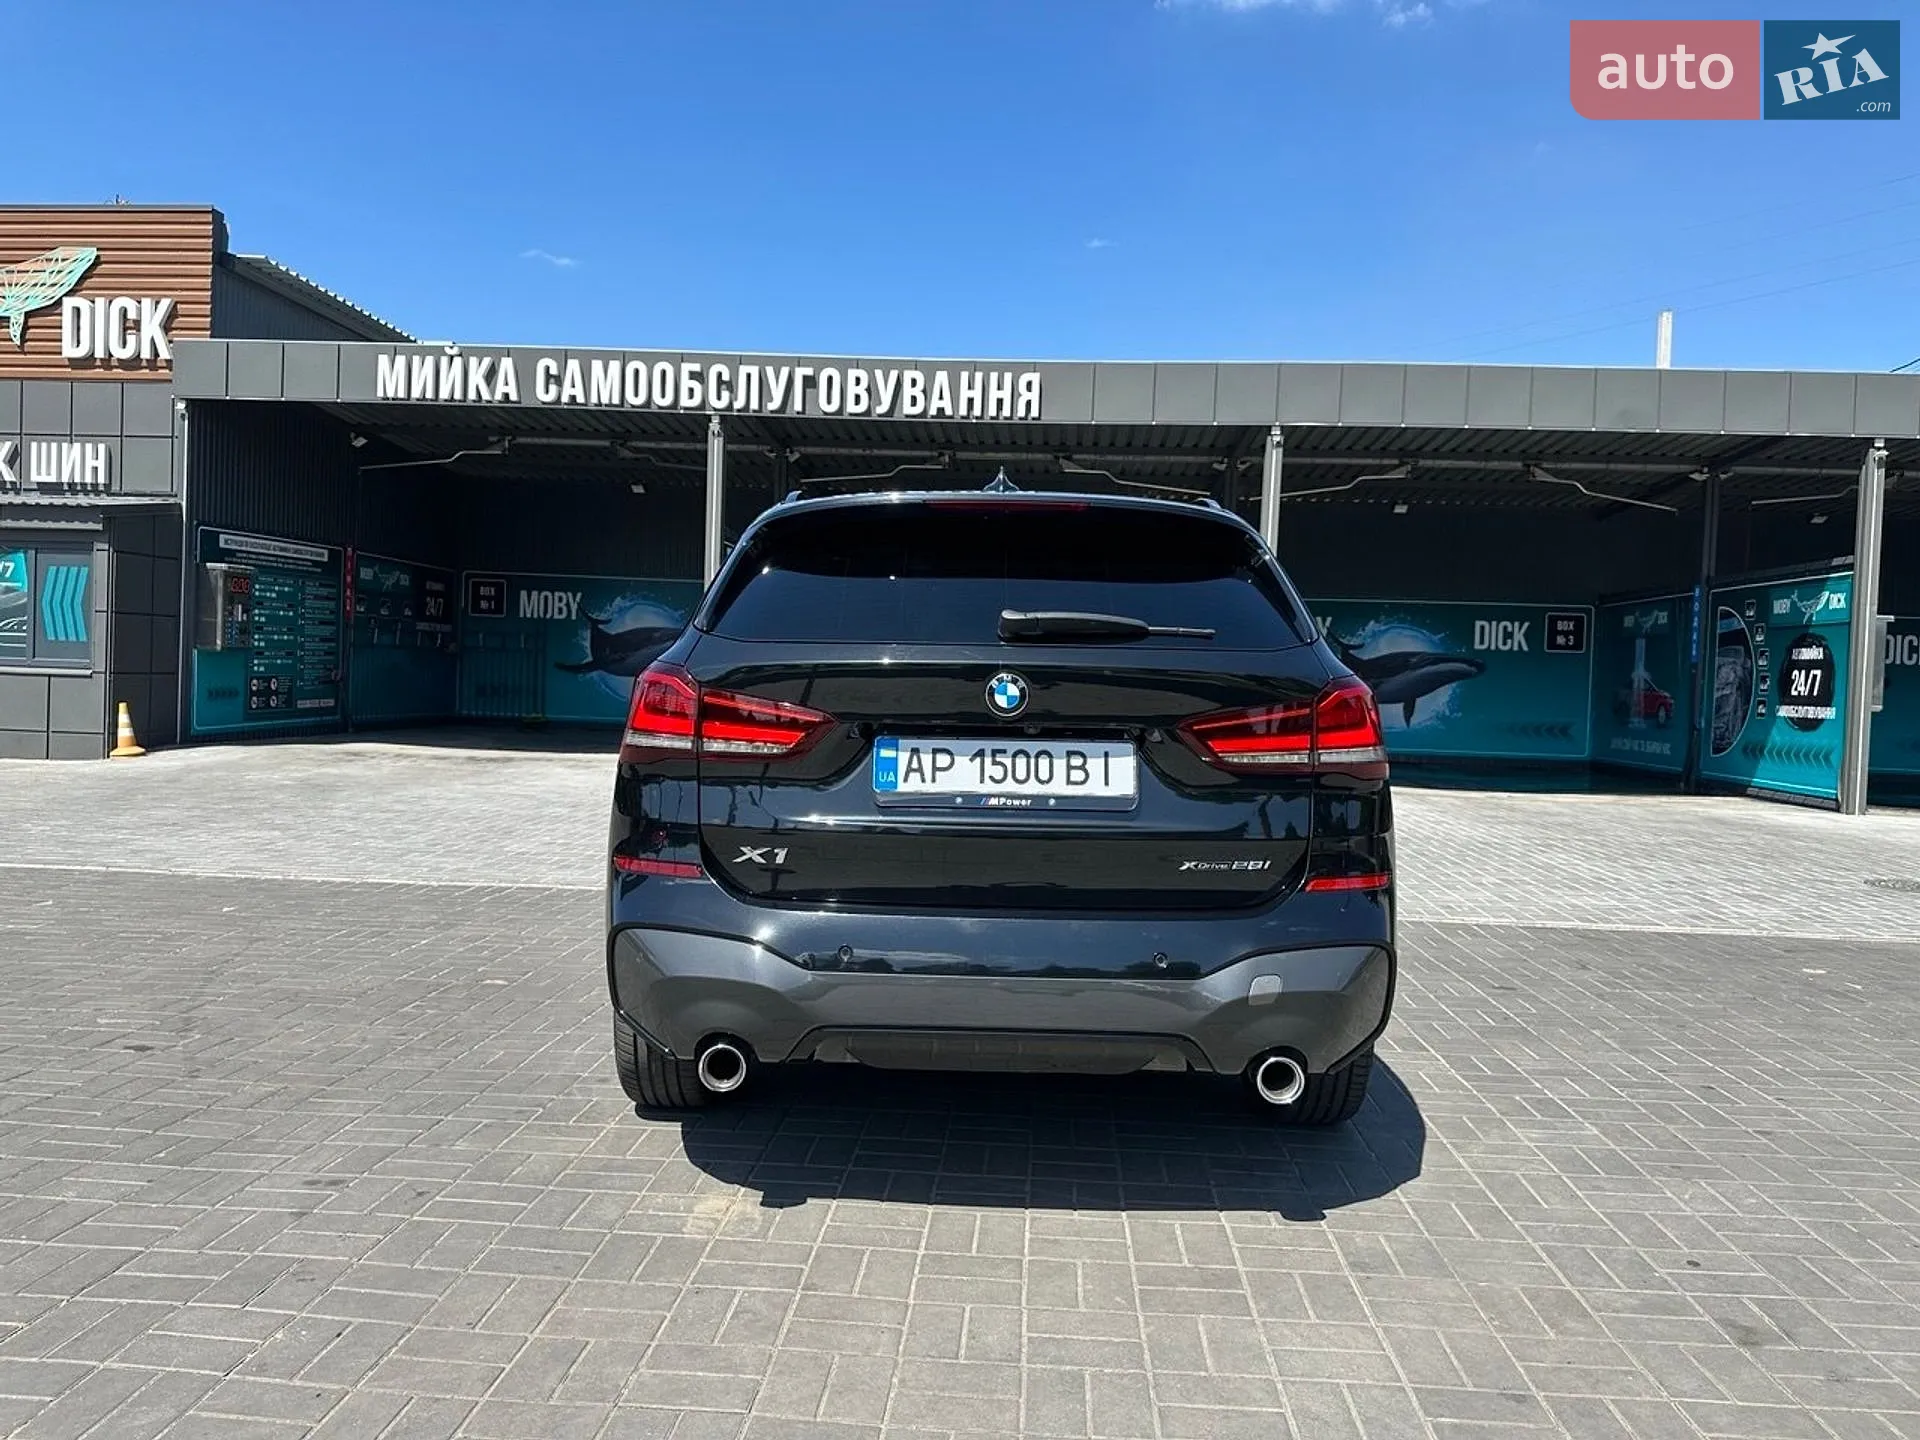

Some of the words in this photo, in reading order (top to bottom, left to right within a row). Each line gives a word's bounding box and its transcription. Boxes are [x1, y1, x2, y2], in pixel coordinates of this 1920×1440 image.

[61, 298, 173, 361] DICK
[376, 346, 520, 401] МИЙКА
[535, 357, 1041, 420] САМООБСЛУГОВУВАННЯ
[30, 441, 107, 484] ШИН
[519, 590, 583, 620] MOBY
[1474, 619, 1530, 651] DICK
[1884, 633, 1920, 666] DIC
[1790, 669, 1822, 696] 24/7
[878, 771, 896, 783] UA
[902, 747, 955, 784] AP
[968, 748, 1054, 786] 1500
[731, 846, 789, 864] X1
